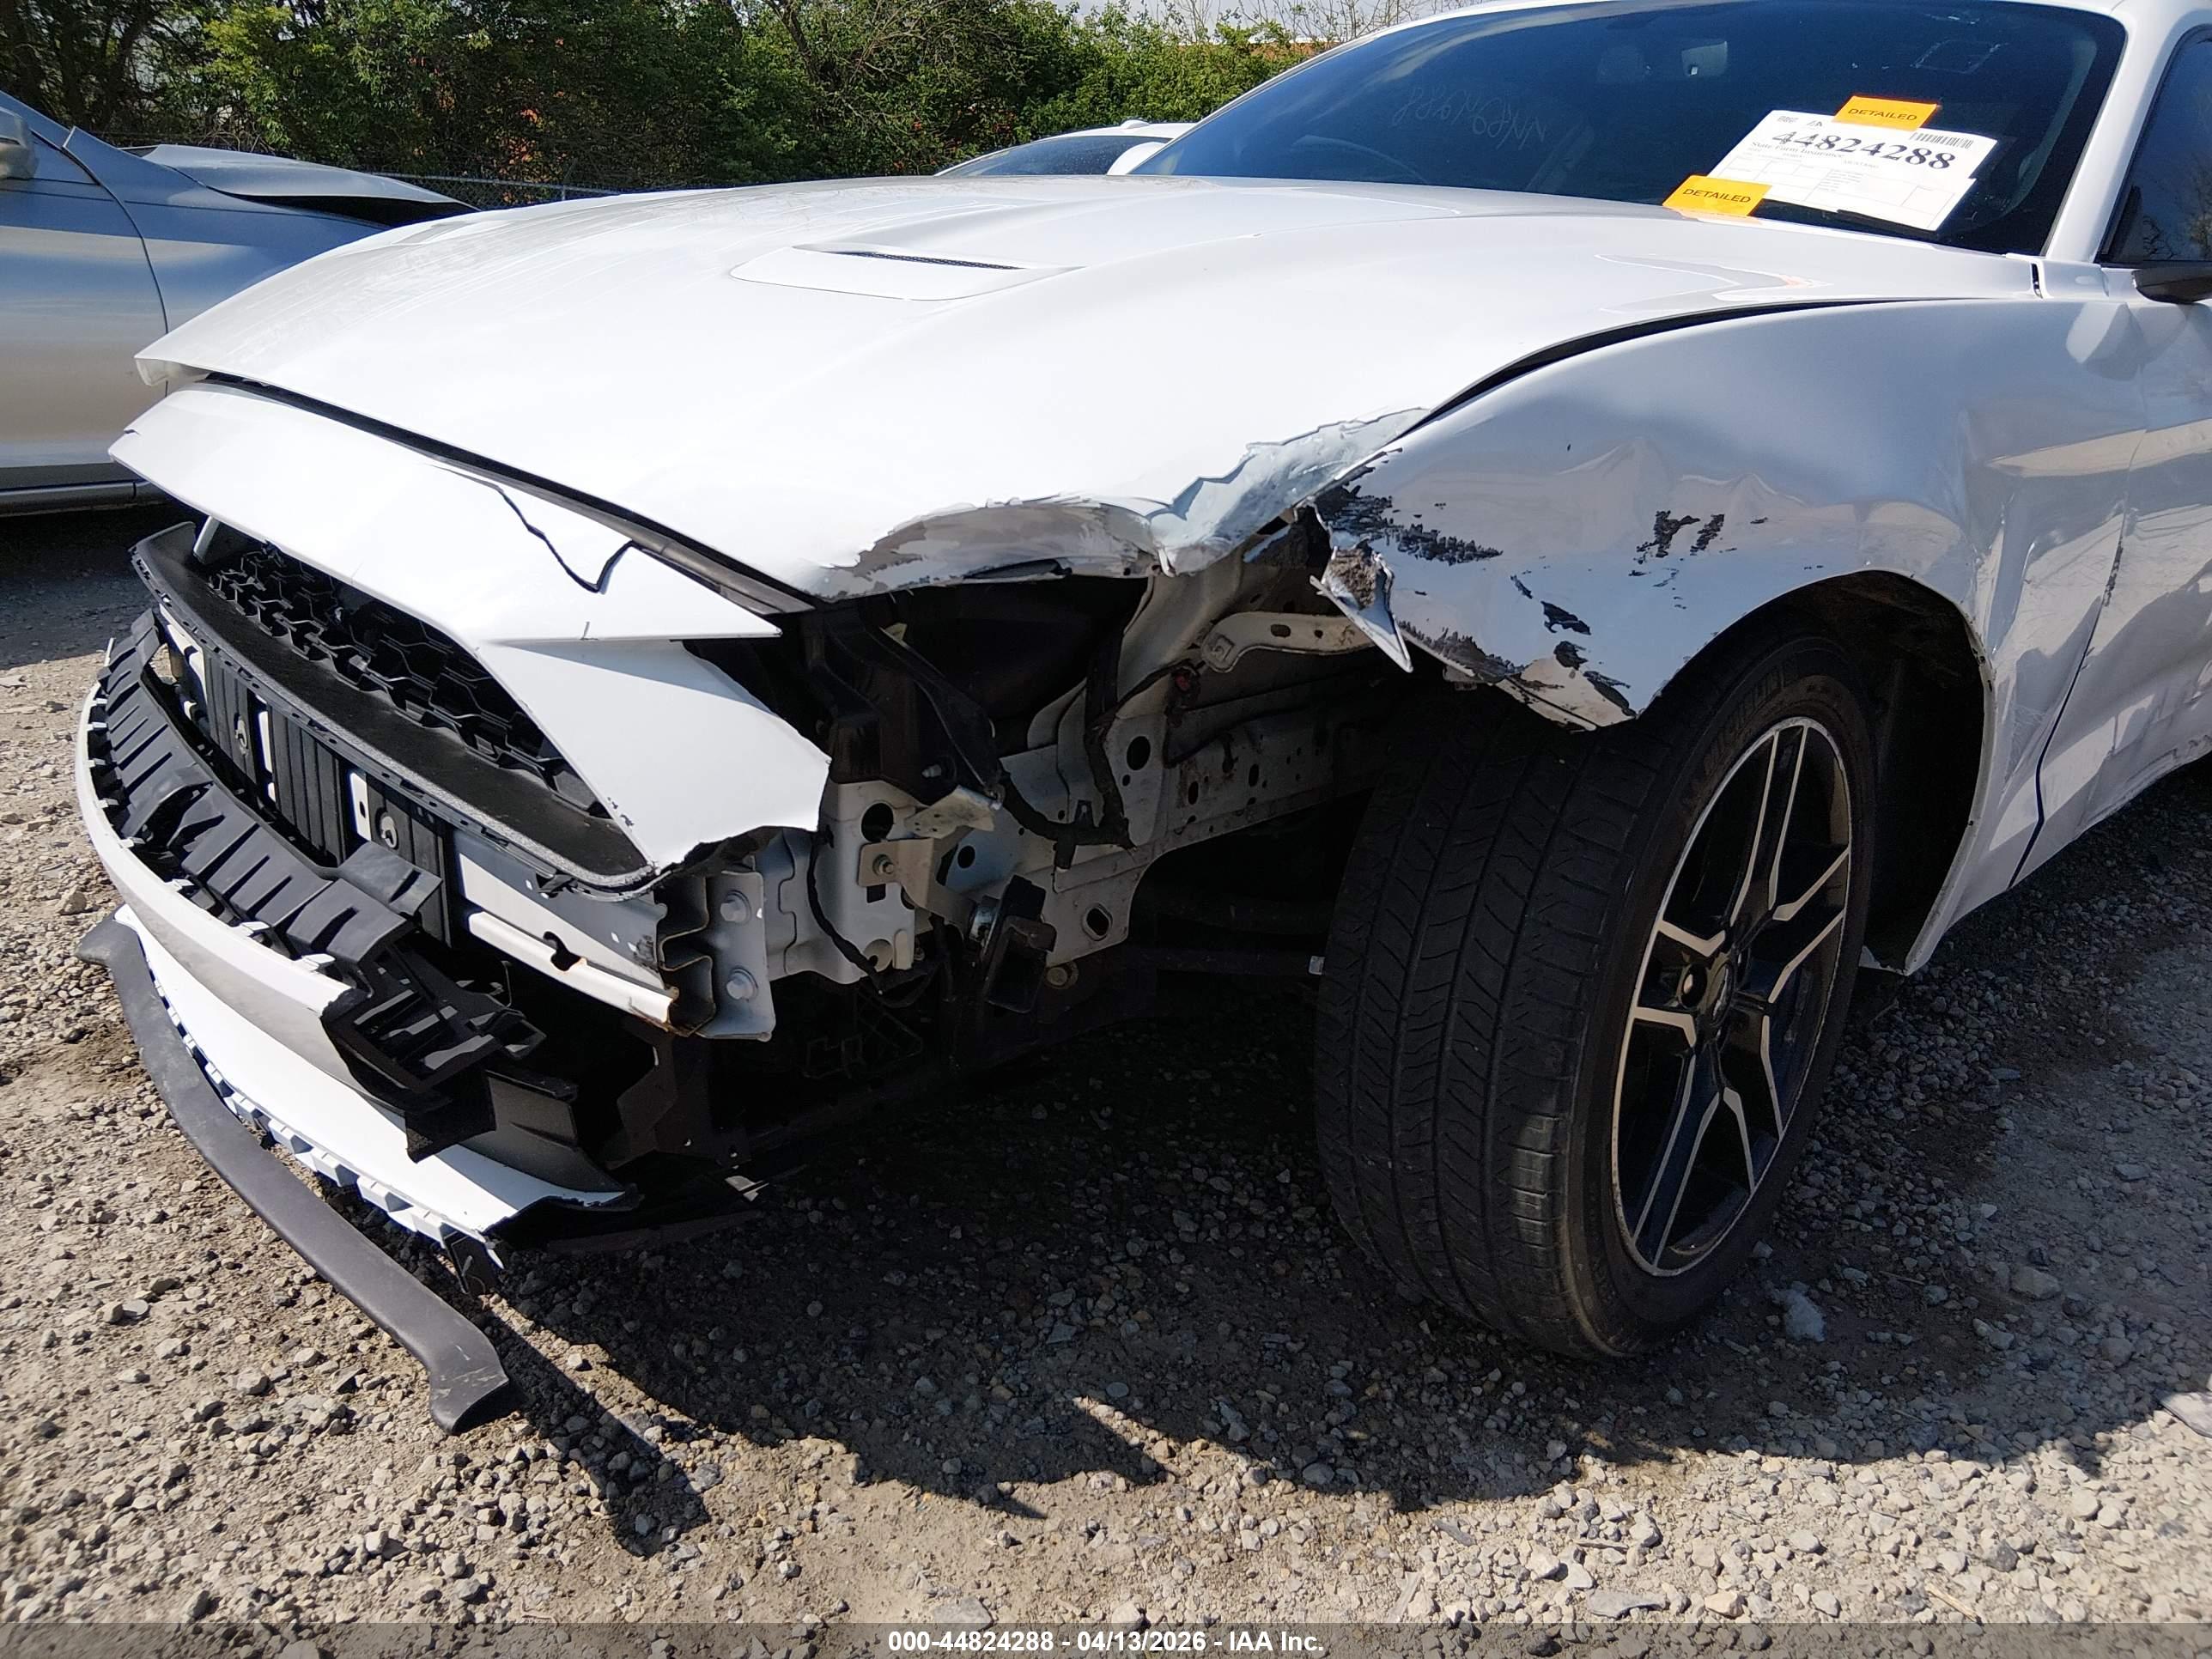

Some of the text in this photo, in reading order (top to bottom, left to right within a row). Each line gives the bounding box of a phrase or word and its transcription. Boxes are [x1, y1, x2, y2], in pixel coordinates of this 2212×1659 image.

[1848, 107, 1917, 122] DETAILED
[1771, 131, 1957, 171] 44824288
[1775, 144, 1799, 153] Farm
[1682, 187, 1752, 204] DETAILED
